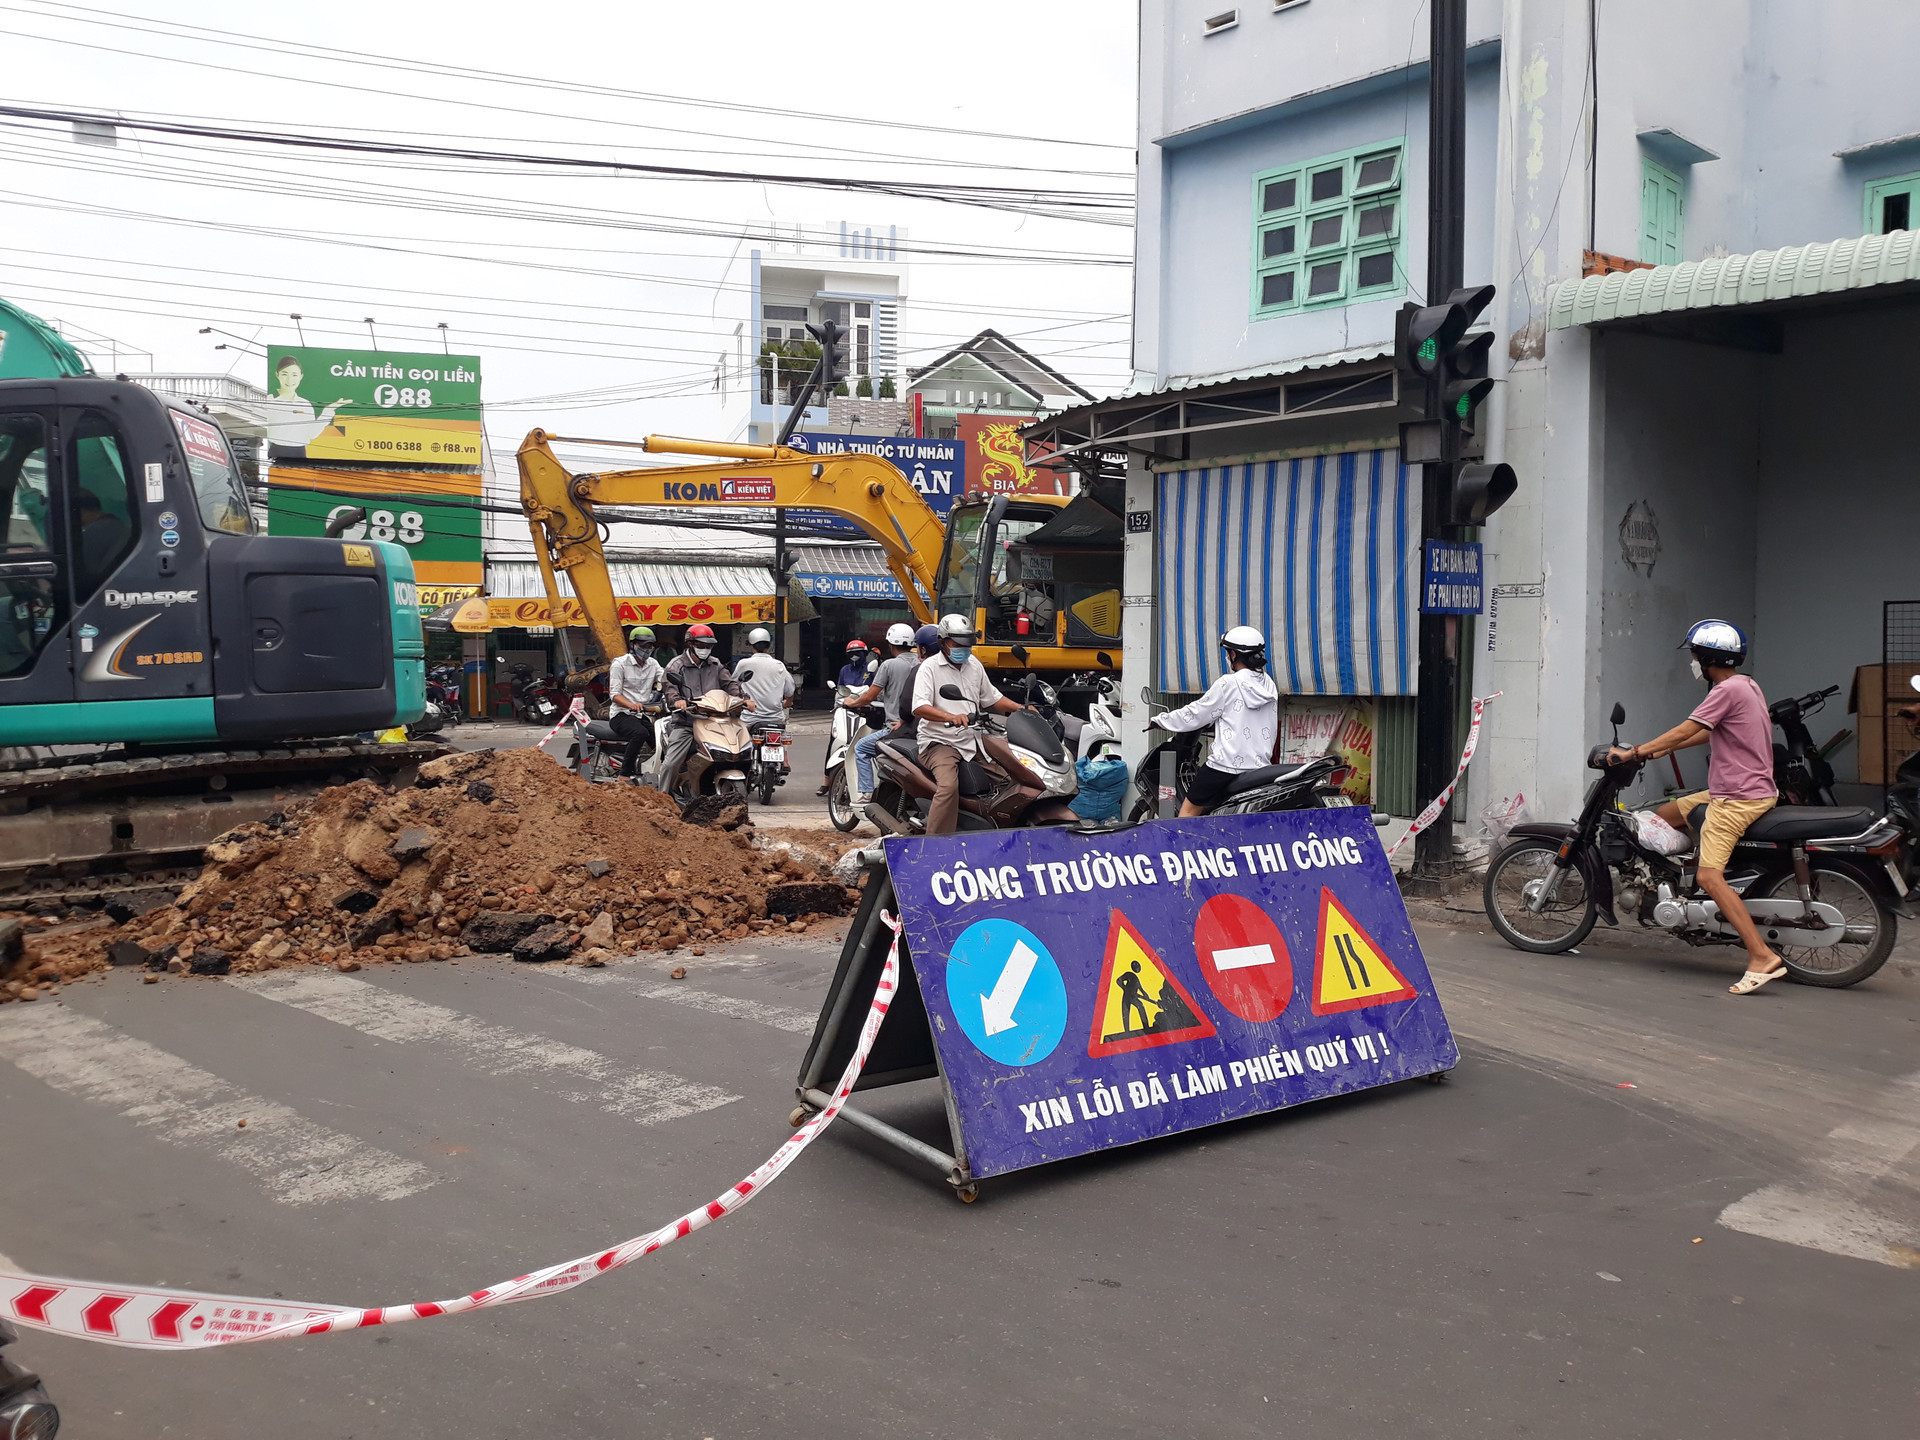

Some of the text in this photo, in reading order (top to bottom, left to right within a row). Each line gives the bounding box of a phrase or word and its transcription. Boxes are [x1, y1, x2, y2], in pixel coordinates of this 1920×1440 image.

[330, 359, 475, 386] CẦN TIỀN GỌI LIỀN
[374, 384, 432, 408] F88
[367, 440, 476, 454] 1800 6388 f88.vn
[817, 438, 954, 461] NHÀ THUỐC TƯ NHÂN
[895, 462, 953, 495] ÂN
[993, 479, 1016, 491] BIA
[663, 482, 720, 501] KOM
[737, 484, 772, 495] KIẾN VIỆT
[1130, 514, 1148, 527] 152
[1432, 548, 1439, 572] XE
[835, 577, 853, 591] NHÀ
[857, 577, 889, 592] THUỐC
[105, 589, 198, 609] Dynaspec
[421, 590, 438, 604] CÓ
[618, 598, 742, 621] ÂY SỐ 1
[931, 832, 1363, 906] CÔNG TRƯỜNG ĐANG THI CÔNG
[1018, 1031, 1391, 1134] XIN LỖI ĐÃ LÀM PHIỀN QUÝ VỊ !
